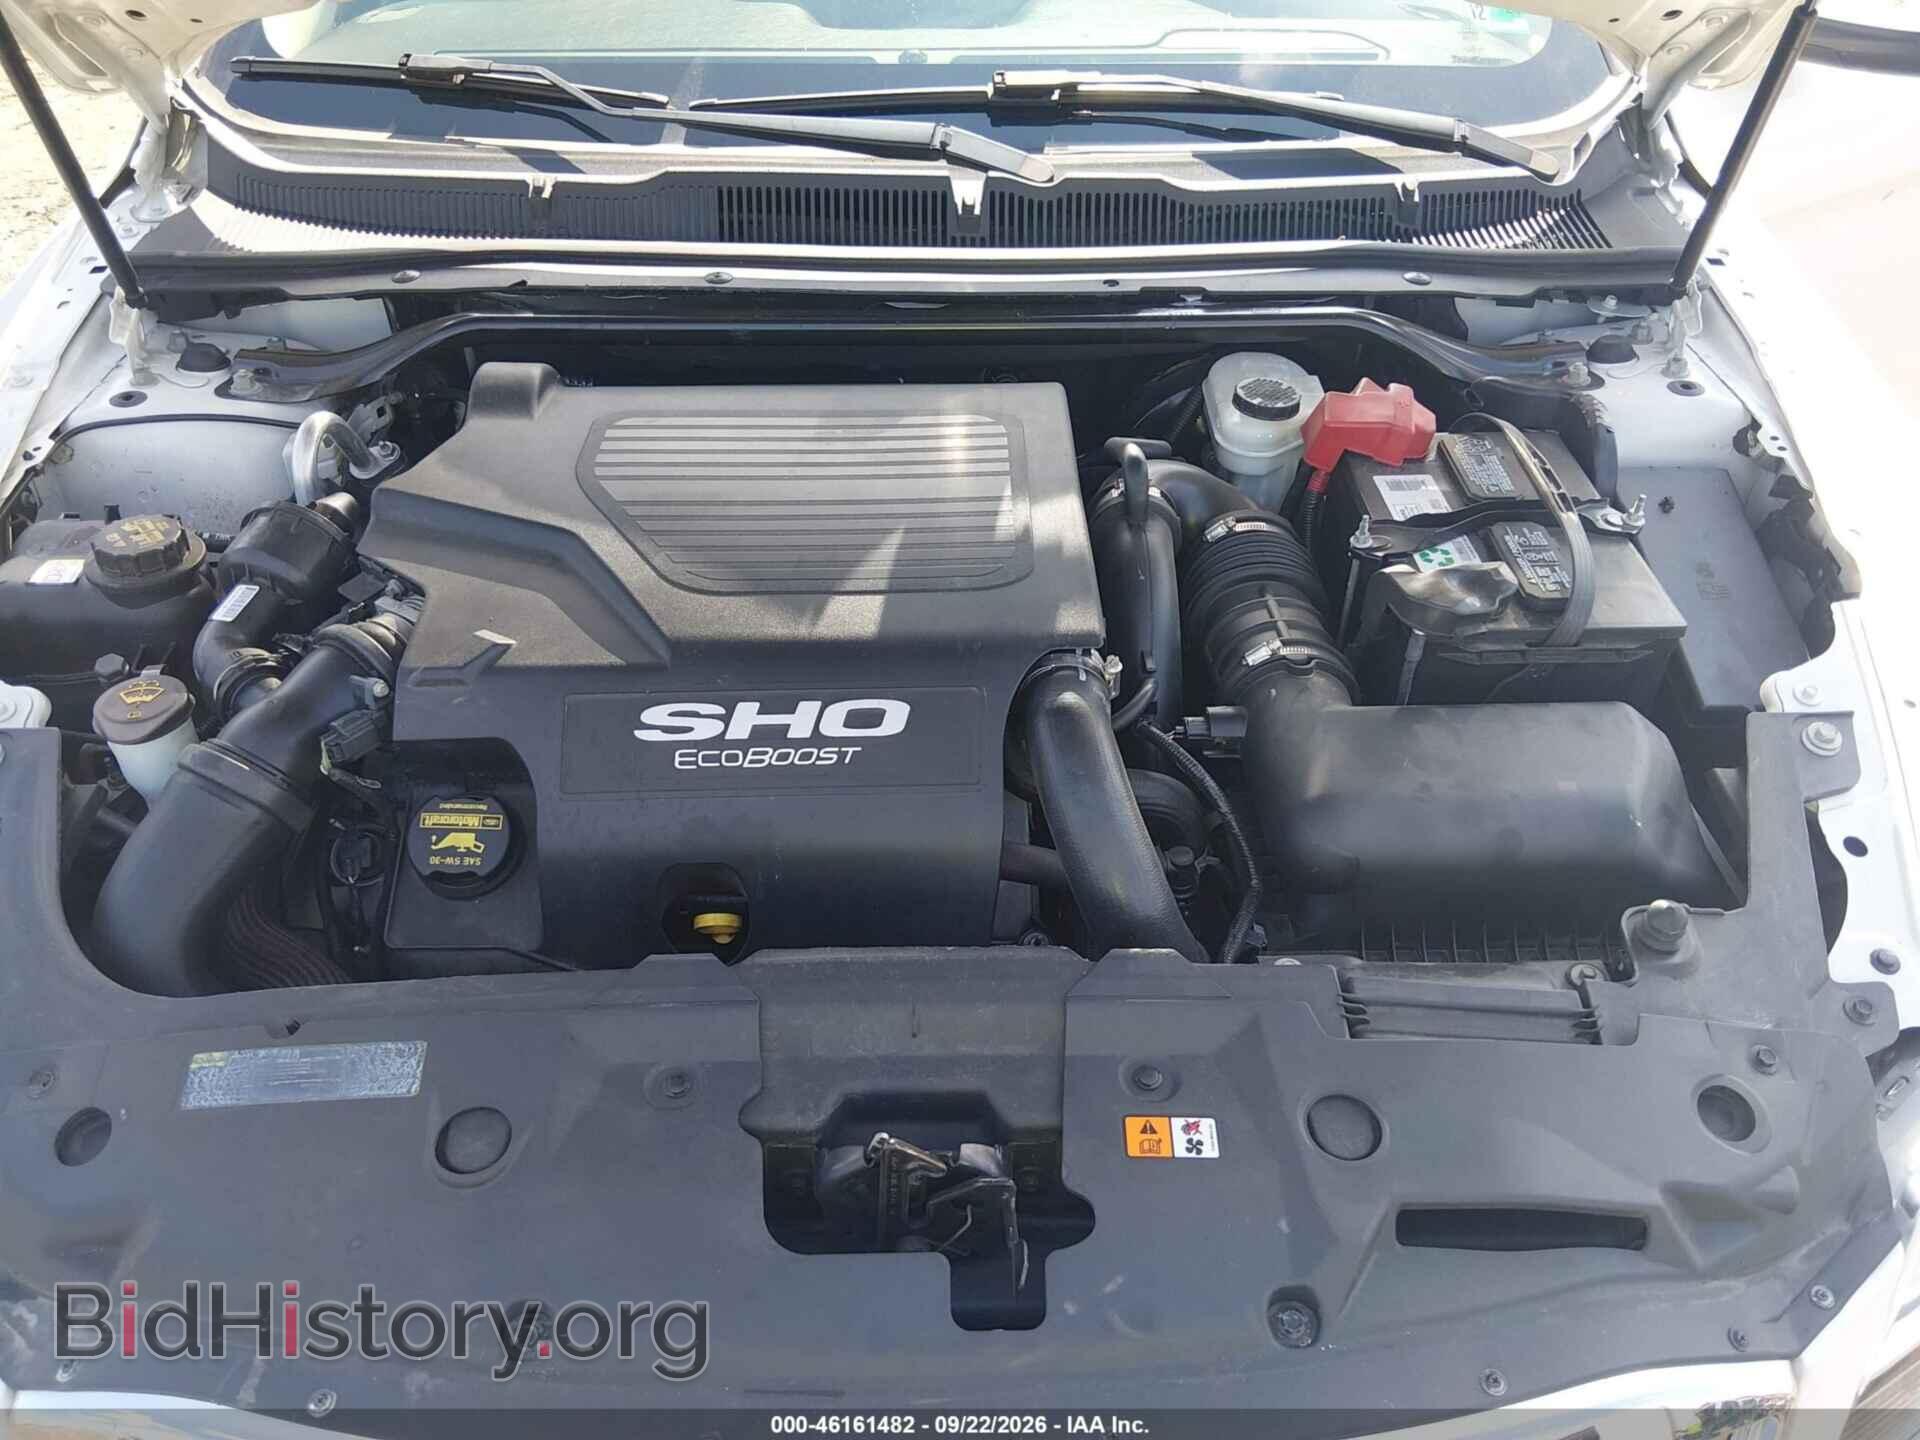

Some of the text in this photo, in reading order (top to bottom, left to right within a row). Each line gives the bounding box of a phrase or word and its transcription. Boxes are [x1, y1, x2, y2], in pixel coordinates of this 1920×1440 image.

[634, 699, 910, 741] SHO
[430, 857, 481, 865] SAE 5W-30
